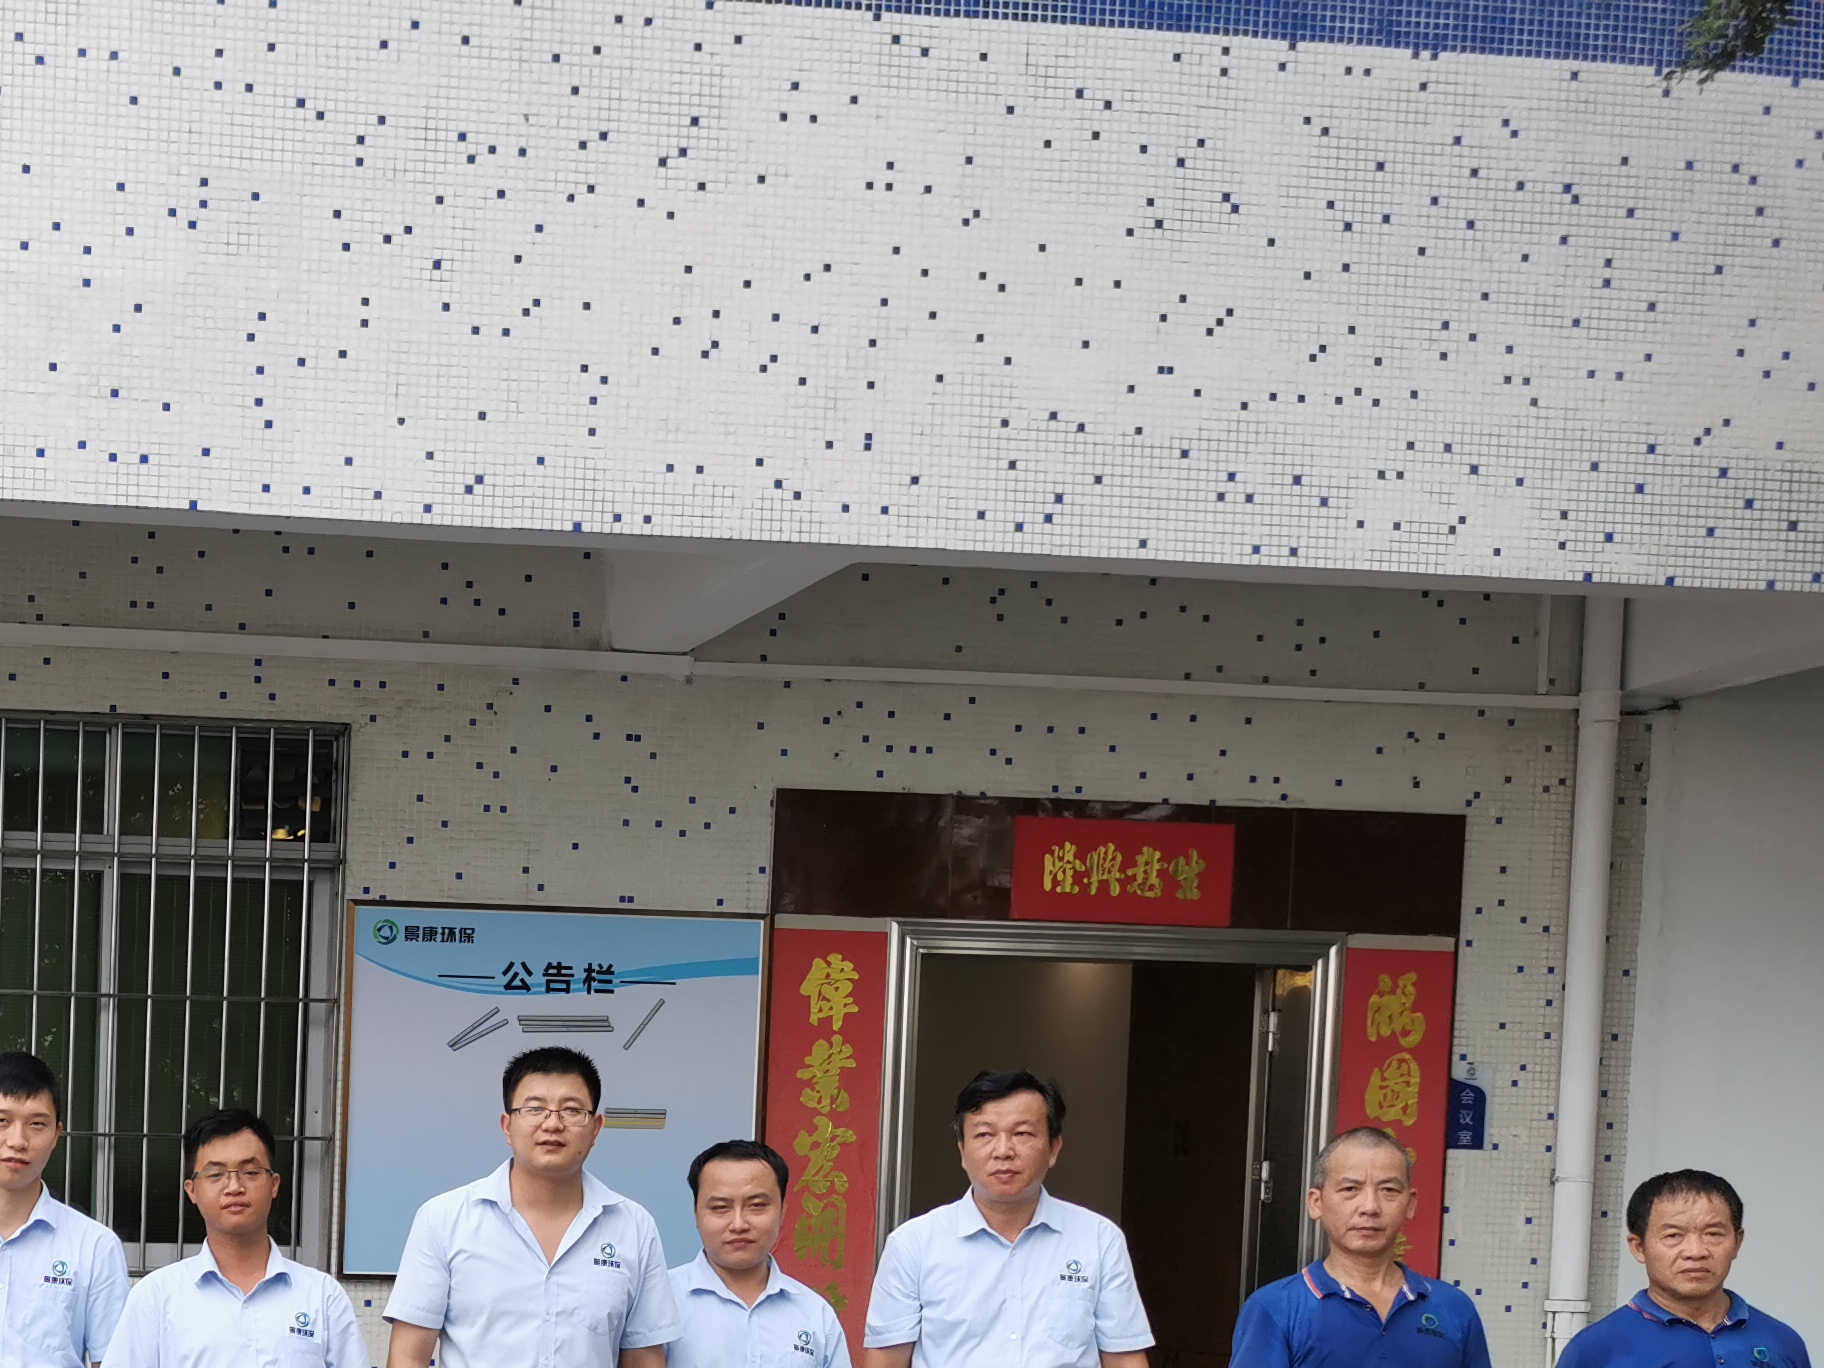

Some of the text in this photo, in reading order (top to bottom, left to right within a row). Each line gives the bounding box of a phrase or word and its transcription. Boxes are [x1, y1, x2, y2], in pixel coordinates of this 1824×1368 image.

[404, 925, 476, 945] 景康环保
[501, 961, 617, 995] 公告栏
[1457, 1088, 1475, 1145] 会议室
